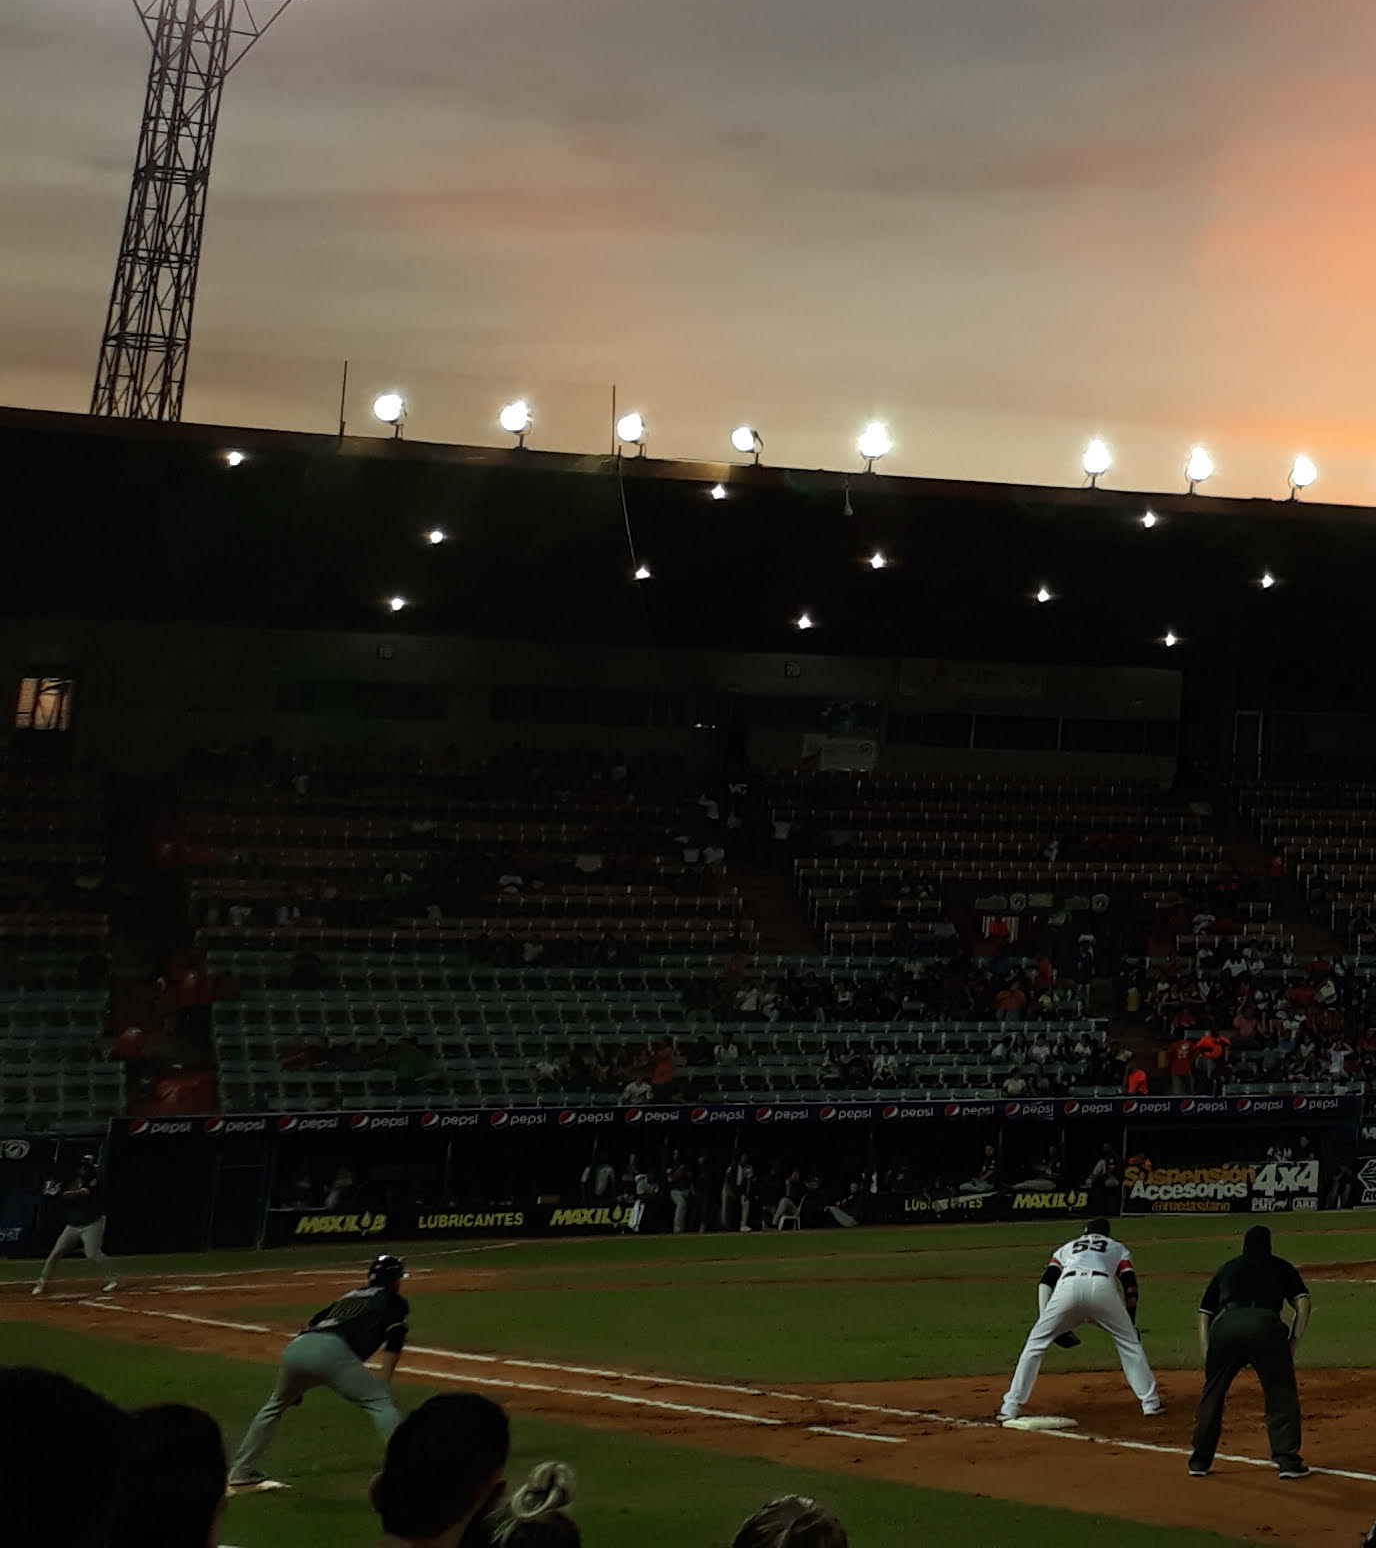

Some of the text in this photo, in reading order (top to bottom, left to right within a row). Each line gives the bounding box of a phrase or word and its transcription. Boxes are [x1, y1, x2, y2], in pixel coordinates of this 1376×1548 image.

[151, 1098, 1339, 1134] pepsi pepsi pepsi pepsi pepsi pepsi pepsi pepsi pepsi pepsi pepsi pepsi pepsi pepsi pepsi pepsi pepsi pepsi pepsi
[1123, 1164, 1256, 1187] Suspensión
[1129, 1179, 1248, 1200] Accesorios
[418, 1212, 524, 1229] LUBRICANTES
[1072, 1239, 1108, 1254] 53
